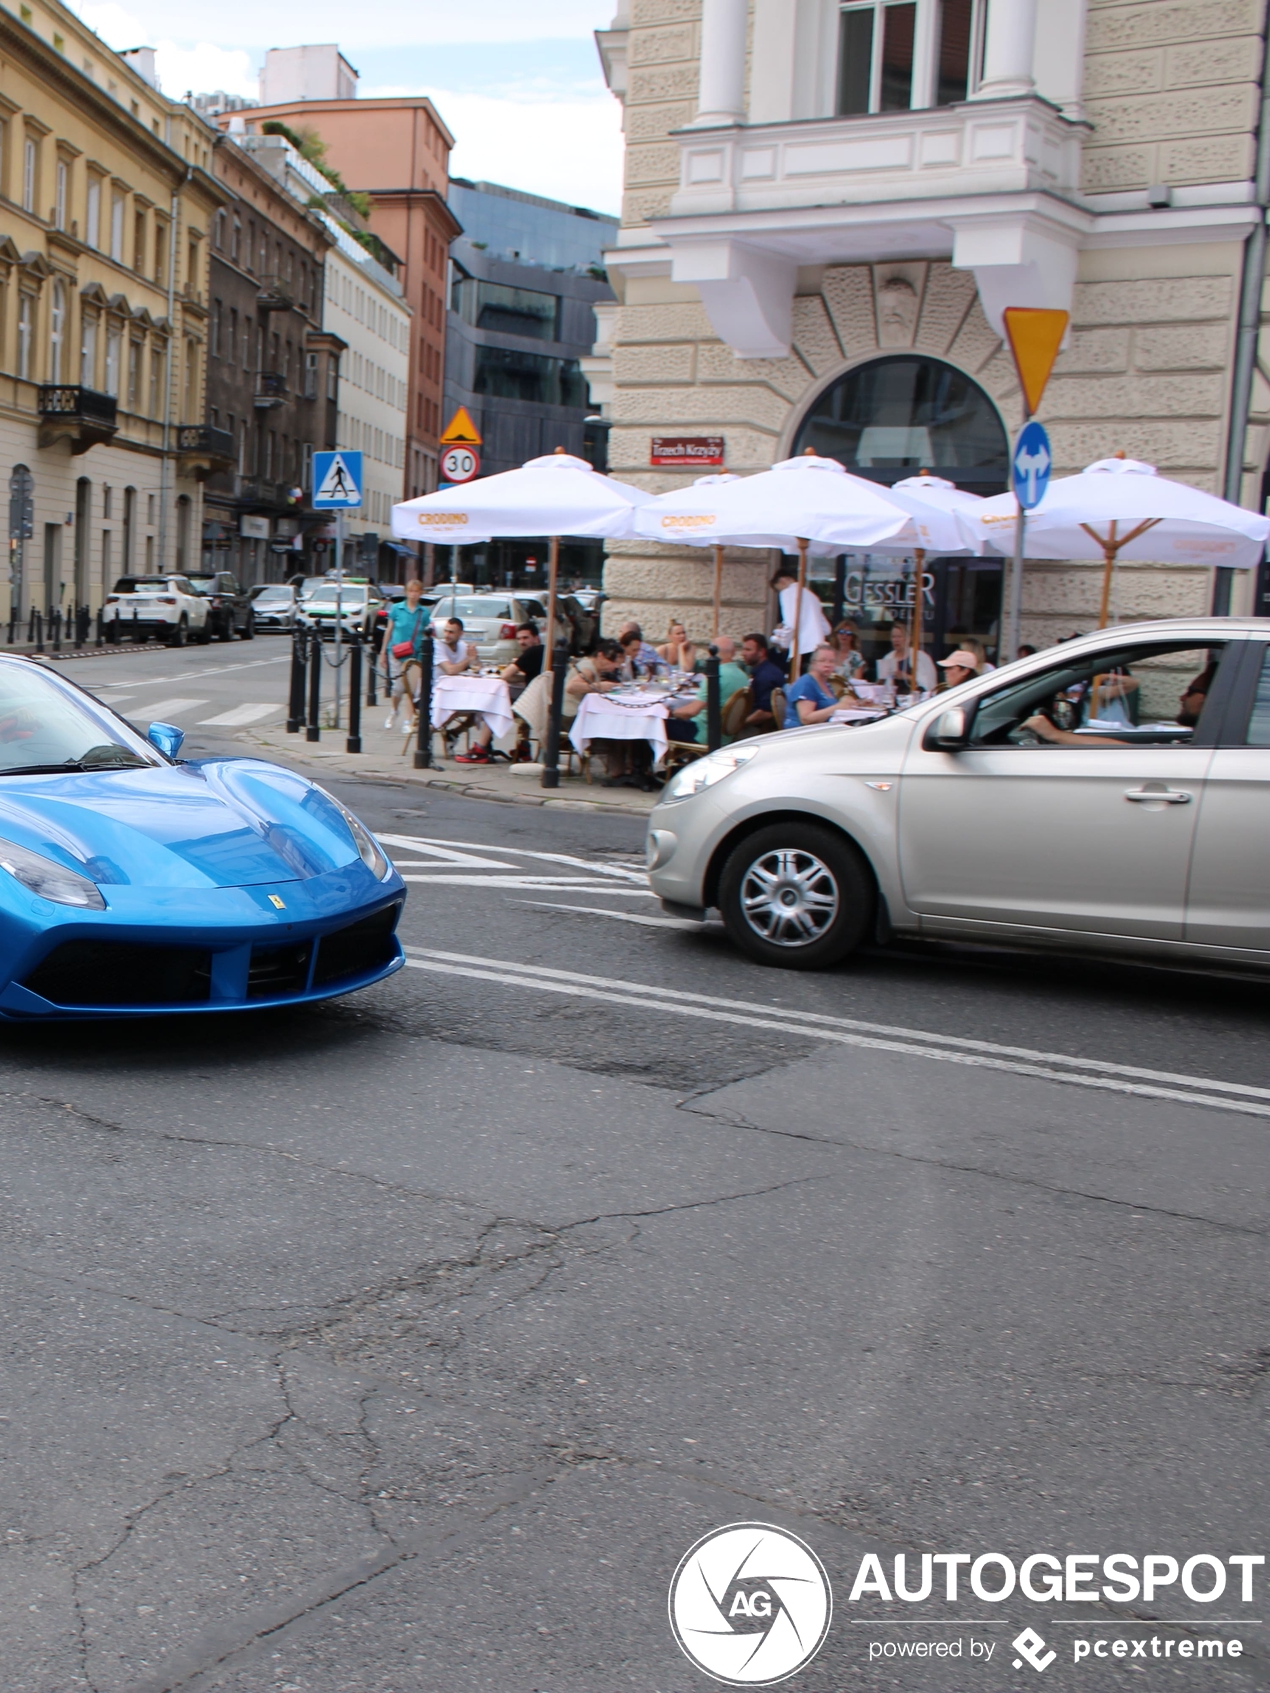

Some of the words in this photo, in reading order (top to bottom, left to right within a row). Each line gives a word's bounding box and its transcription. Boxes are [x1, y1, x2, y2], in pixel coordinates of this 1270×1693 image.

[653, 443, 685, 455] Trzech
[686, 443, 722, 459] Krzyży
[447, 455, 473, 472] 30
[419, 513, 468, 525] CRODINO
[662, 515, 716, 528] CRODINO
